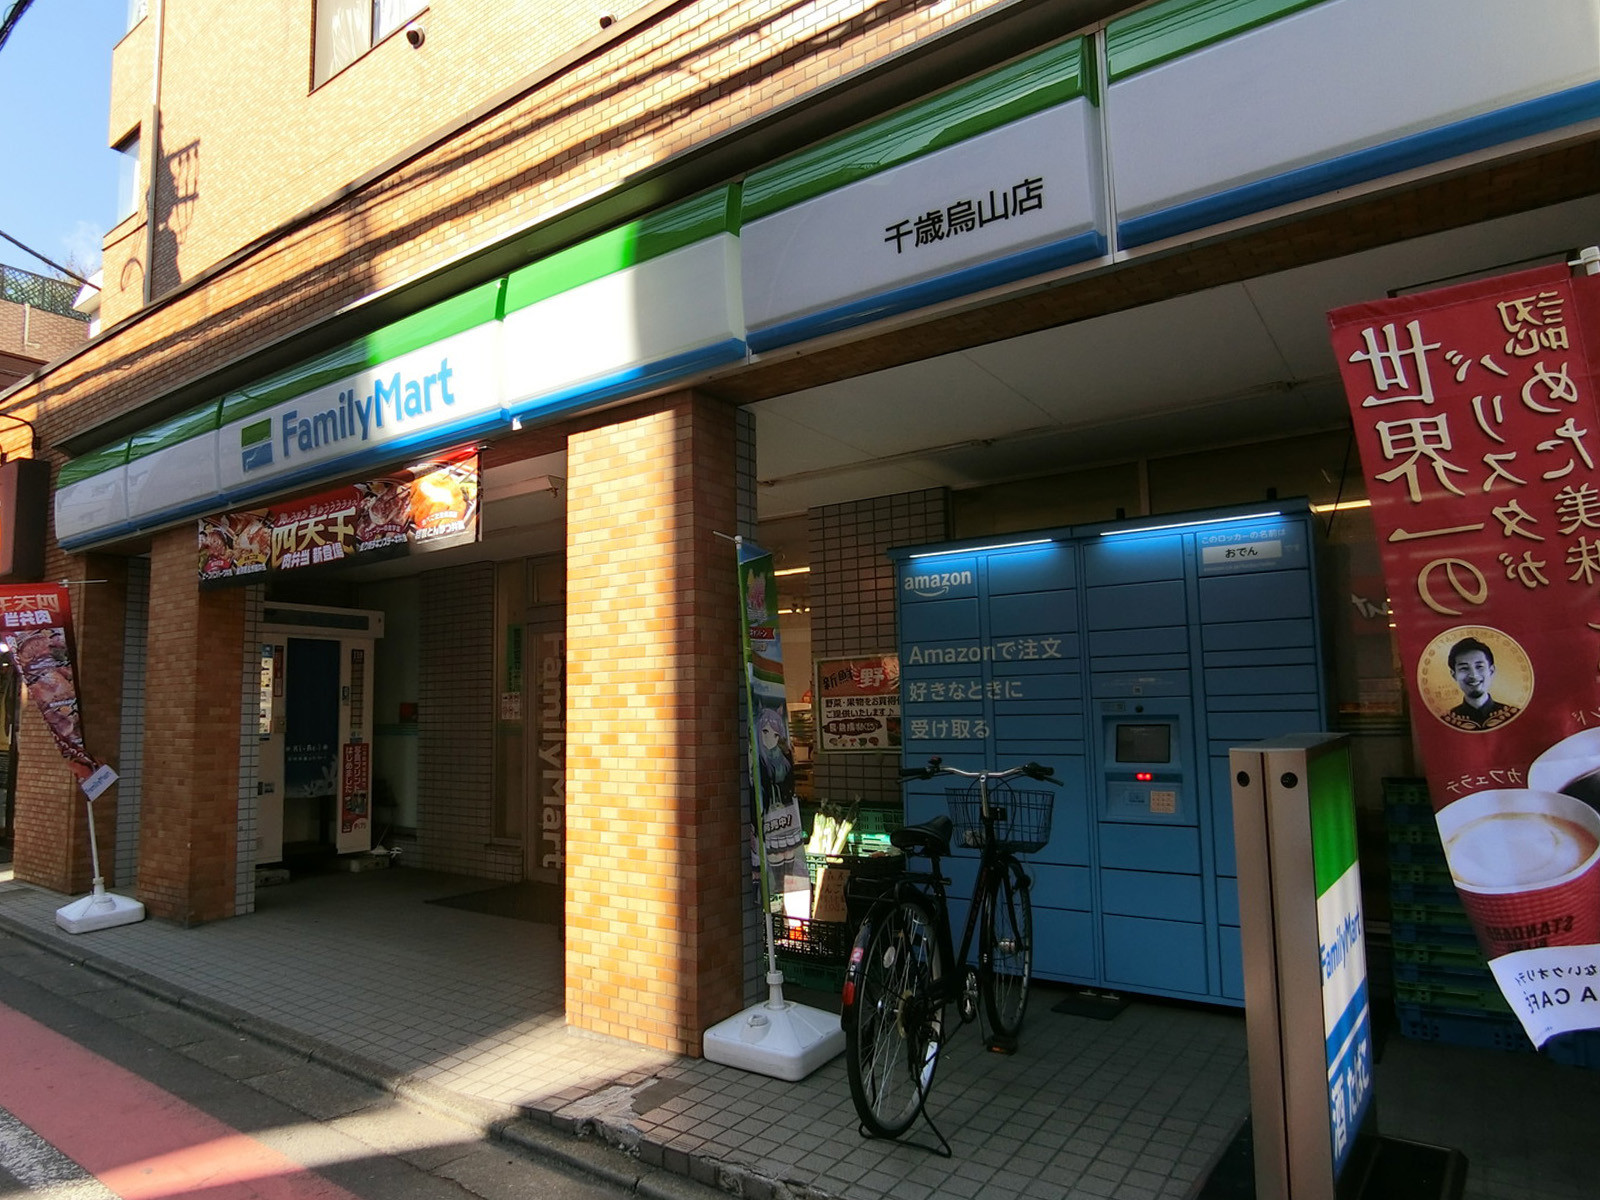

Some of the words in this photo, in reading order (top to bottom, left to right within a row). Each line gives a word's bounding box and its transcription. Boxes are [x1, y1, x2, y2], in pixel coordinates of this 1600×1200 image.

[884, 177, 1044, 254] 千歳烏山店
[282, 357, 456, 459] FamilyMart
[271, 506, 357, 568] 四天王
[1201, 528, 1287, 545] このロッカーの名前は
[1224, 546, 1258, 559] おでん
[281, 548, 310, 570] 肉弁当
[904, 570, 972, 590] amazon
[908, 637, 1063, 665] Amazonで注文
[908, 680, 1024, 701] 好きなときに
[910, 718, 991, 740] 受け取る
[345, 746, 354, 793] はじめました
[537, 632, 564, 870] FamilyMart
[1320, 912, 1361, 986] FamilyMart
[1332, 1073, 1347, 1160] 酒
[1347, 1038, 1370, 1124] たばこ
